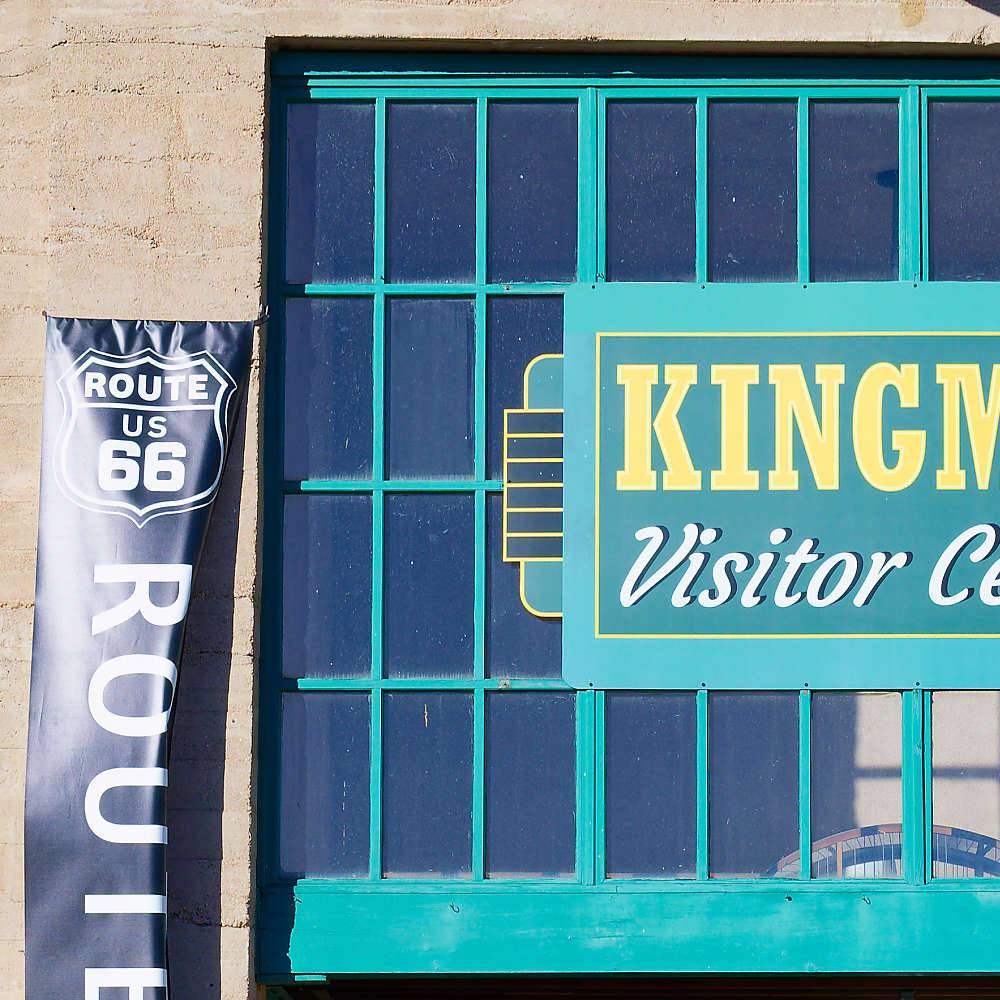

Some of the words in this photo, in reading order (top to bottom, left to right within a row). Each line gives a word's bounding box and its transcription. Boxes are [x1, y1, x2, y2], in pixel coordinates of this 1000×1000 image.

[84, 372, 209, 402] ROUTE
[122, 415, 168, 438] US
[98, 440, 187, 492] 66
[619, 523, 913, 608] Visitor
